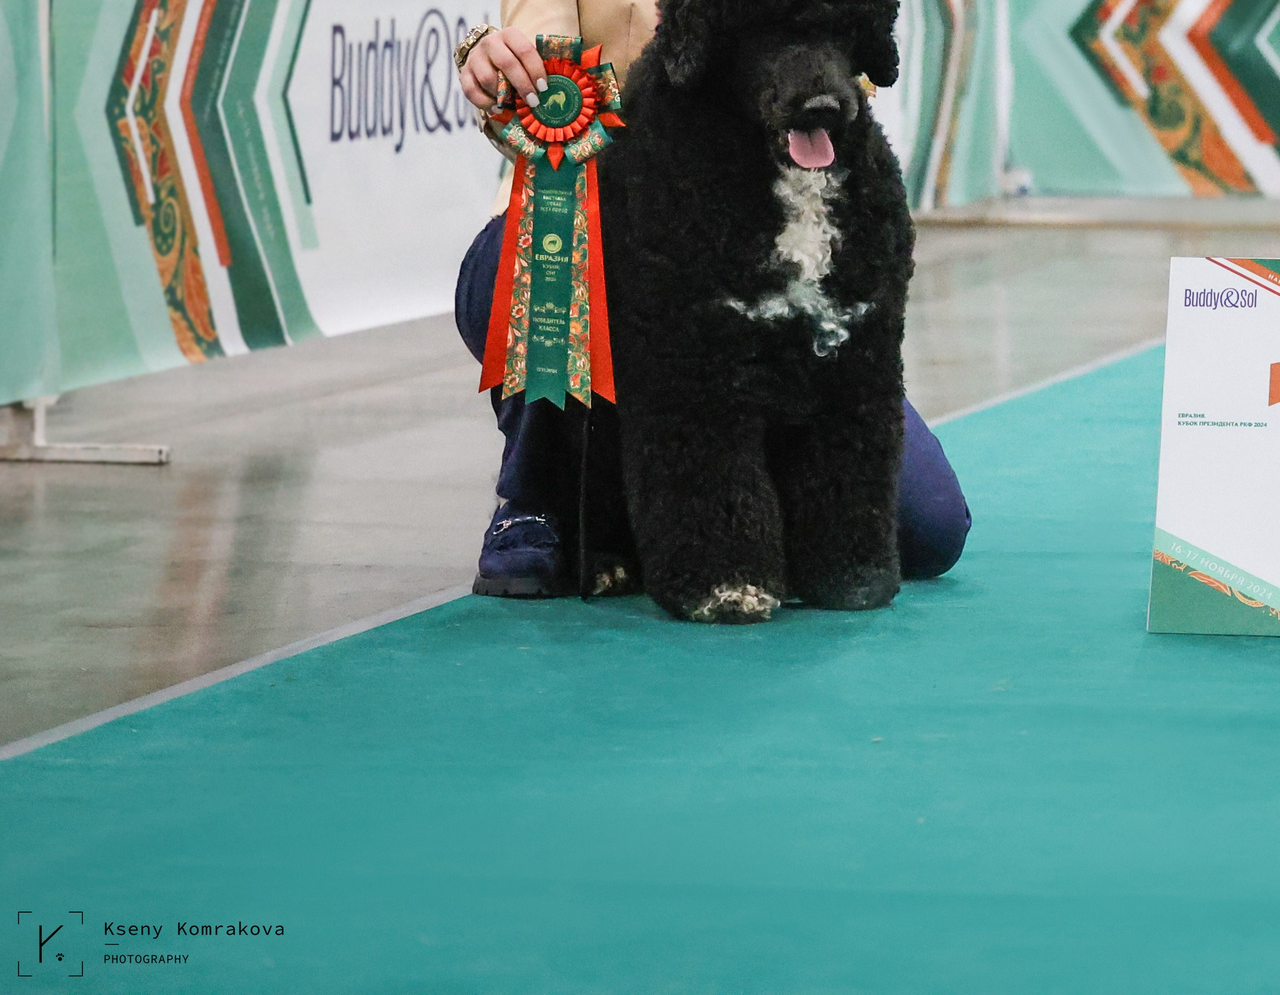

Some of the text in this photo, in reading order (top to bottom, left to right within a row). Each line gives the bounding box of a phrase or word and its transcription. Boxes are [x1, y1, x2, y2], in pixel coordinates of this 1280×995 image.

[535, 253, 570, 263] ЕВРАЗИЯ
[1199, 420, 1239, 428] ПРЕЗИДЕНТА
[1199, 556, 1245, 586] НОЯБРЯ
[1246, 581, 1273, 600] 2024
